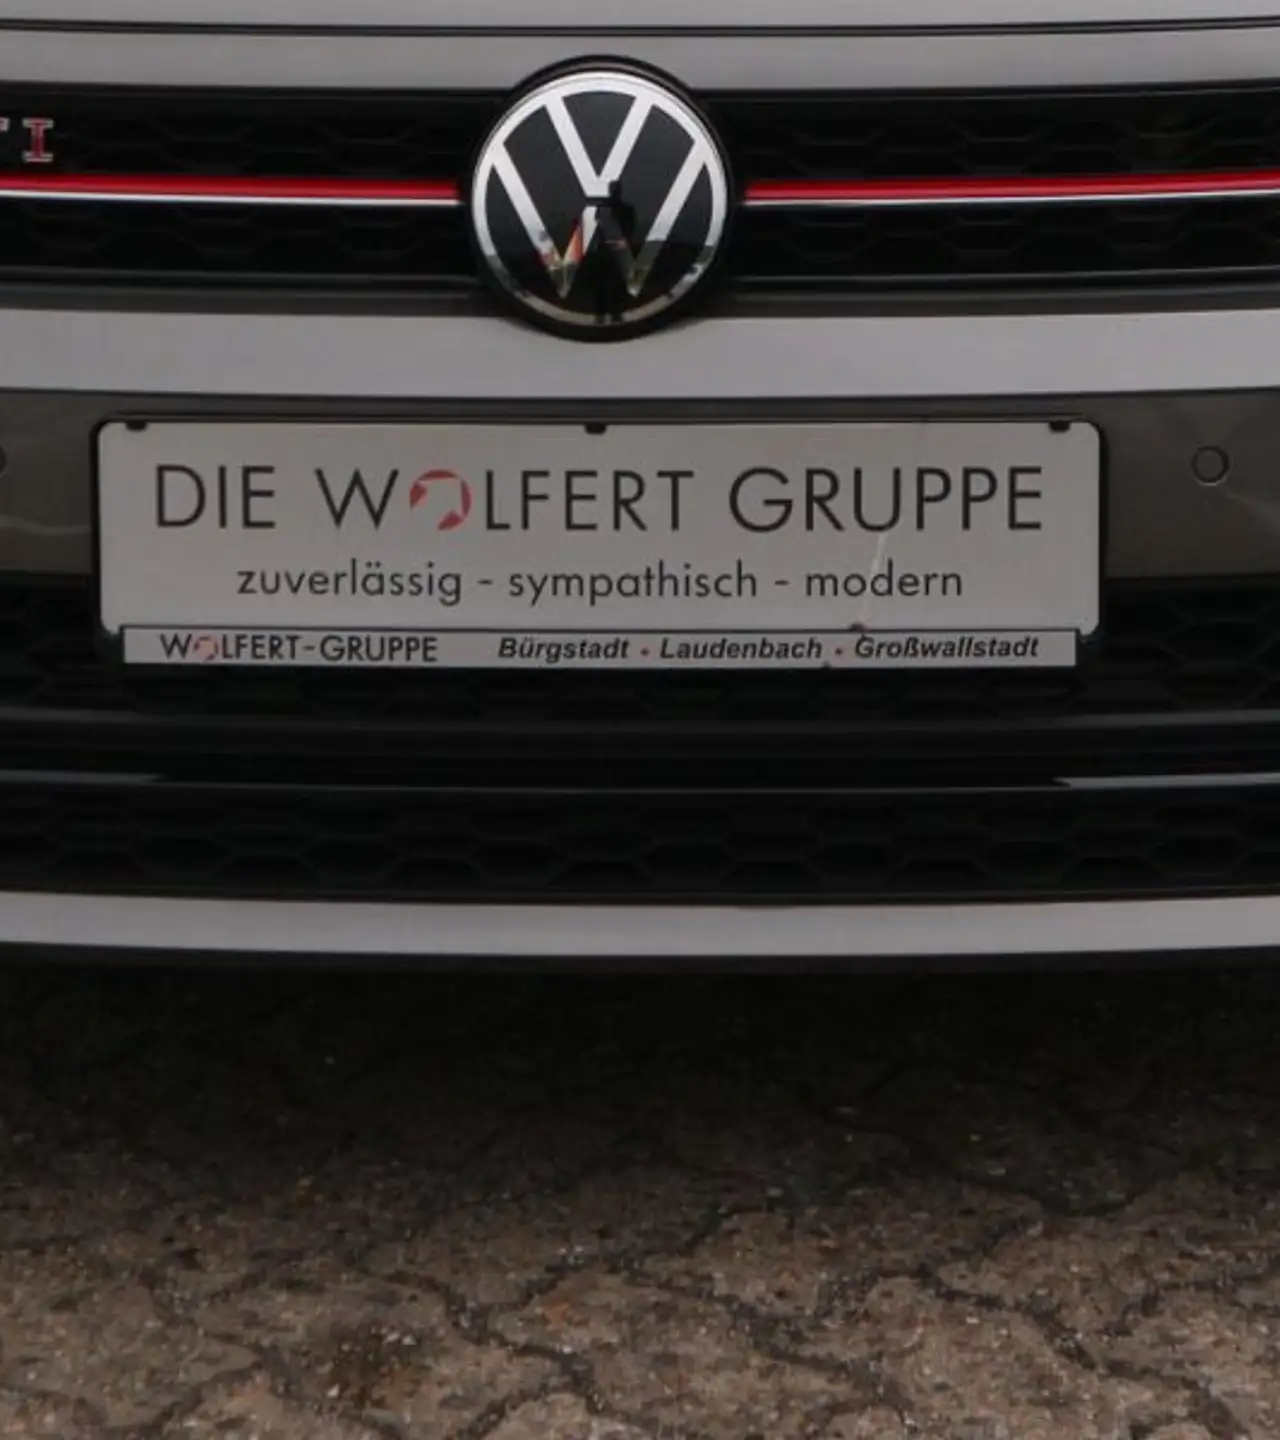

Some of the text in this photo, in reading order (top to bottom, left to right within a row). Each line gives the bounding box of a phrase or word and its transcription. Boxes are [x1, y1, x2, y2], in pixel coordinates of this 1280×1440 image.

[155, 463, 1043, 533] DIE WOLFERT GRUPPE
[237, 558, 462, 606] zuverlässig
[508, 558, 758, 607] sympathisch
[806, 558, 963, 598] modern
[160, 632, 1039, 663] WOLFERT-GRUPPE Bürgstadt Laudenbach Großwallstadt
